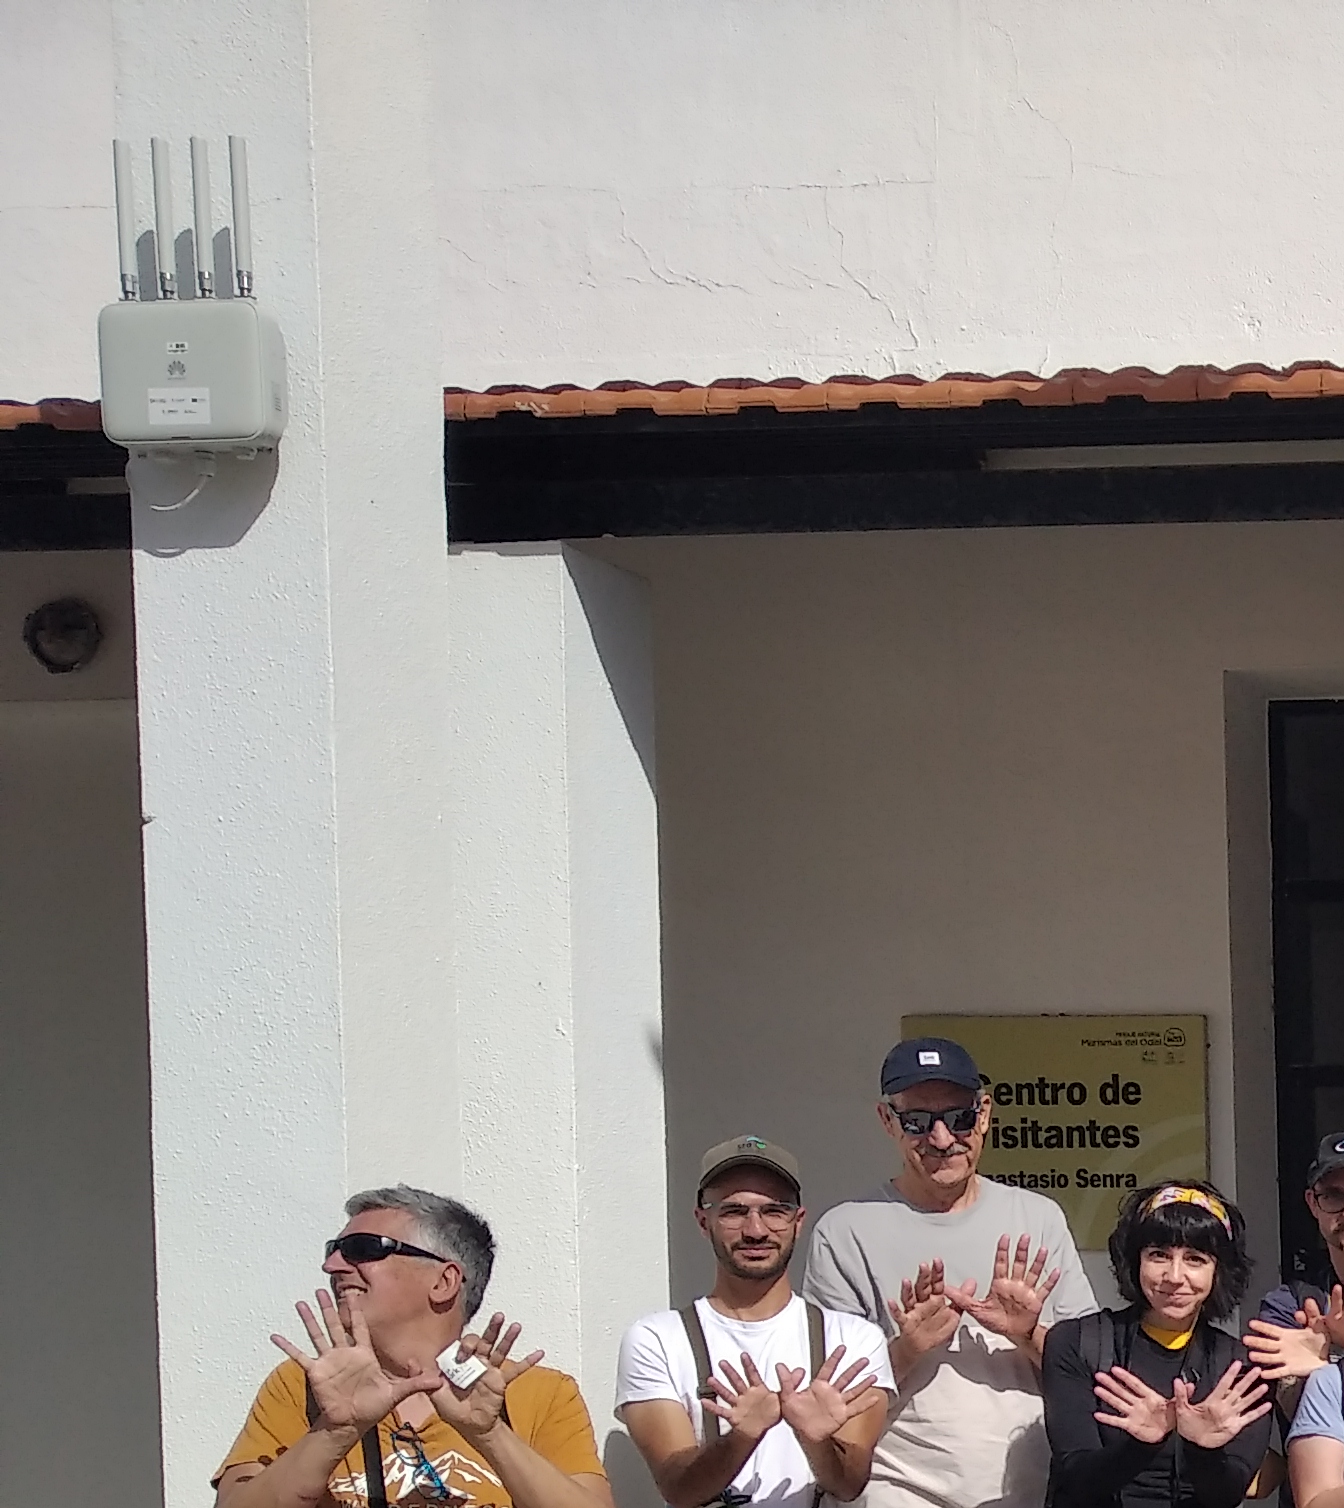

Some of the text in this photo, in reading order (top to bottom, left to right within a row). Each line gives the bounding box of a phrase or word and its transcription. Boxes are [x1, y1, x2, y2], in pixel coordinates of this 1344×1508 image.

[979, 1073, 1142, 1106] entro de
[982, 1117, 1141, 1149] isitantes
[1076, 1168, 1137, 1189] Senra
